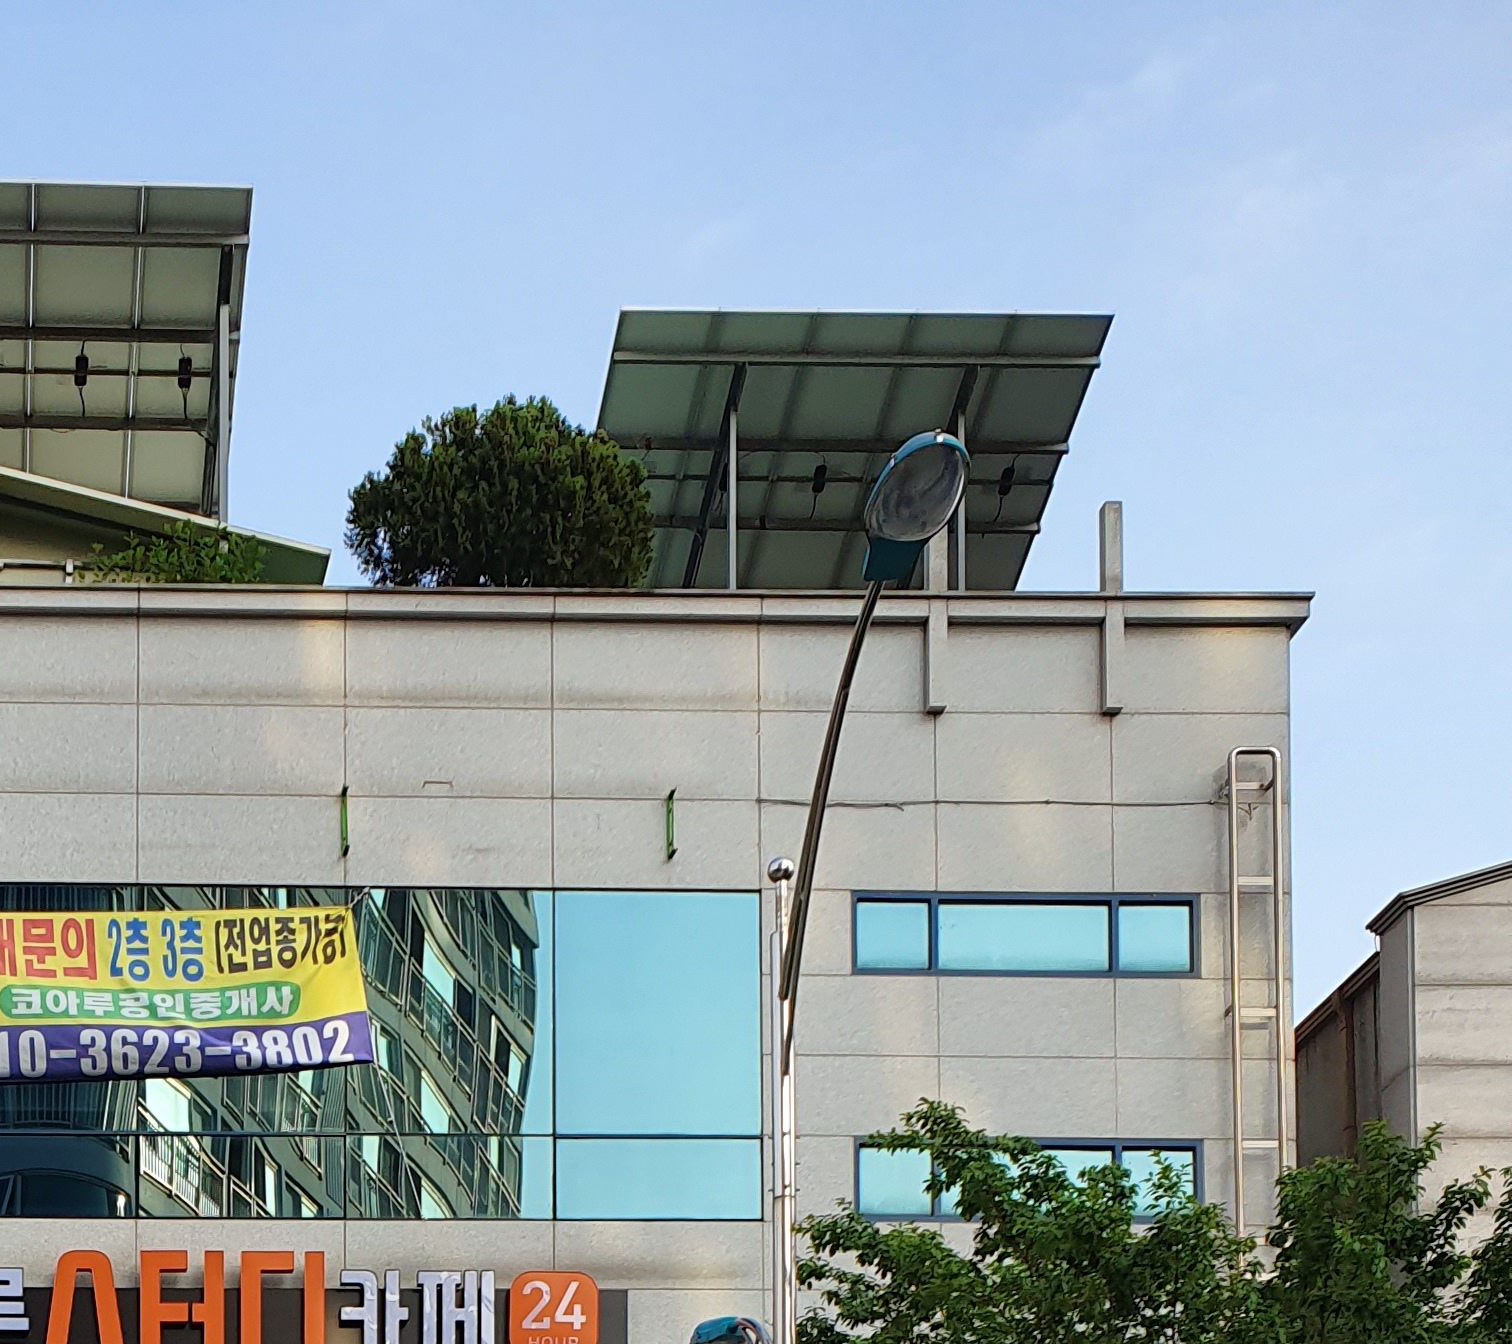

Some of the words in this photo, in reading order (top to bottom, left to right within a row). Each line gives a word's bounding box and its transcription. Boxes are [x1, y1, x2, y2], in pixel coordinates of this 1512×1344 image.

[107, 917, 150, 982] 2층
[162, 918, 204, 982] 3층
[9, 985, 293, 1019] 코아루공인중개사
[520, 1280, 587, 1332] 24
